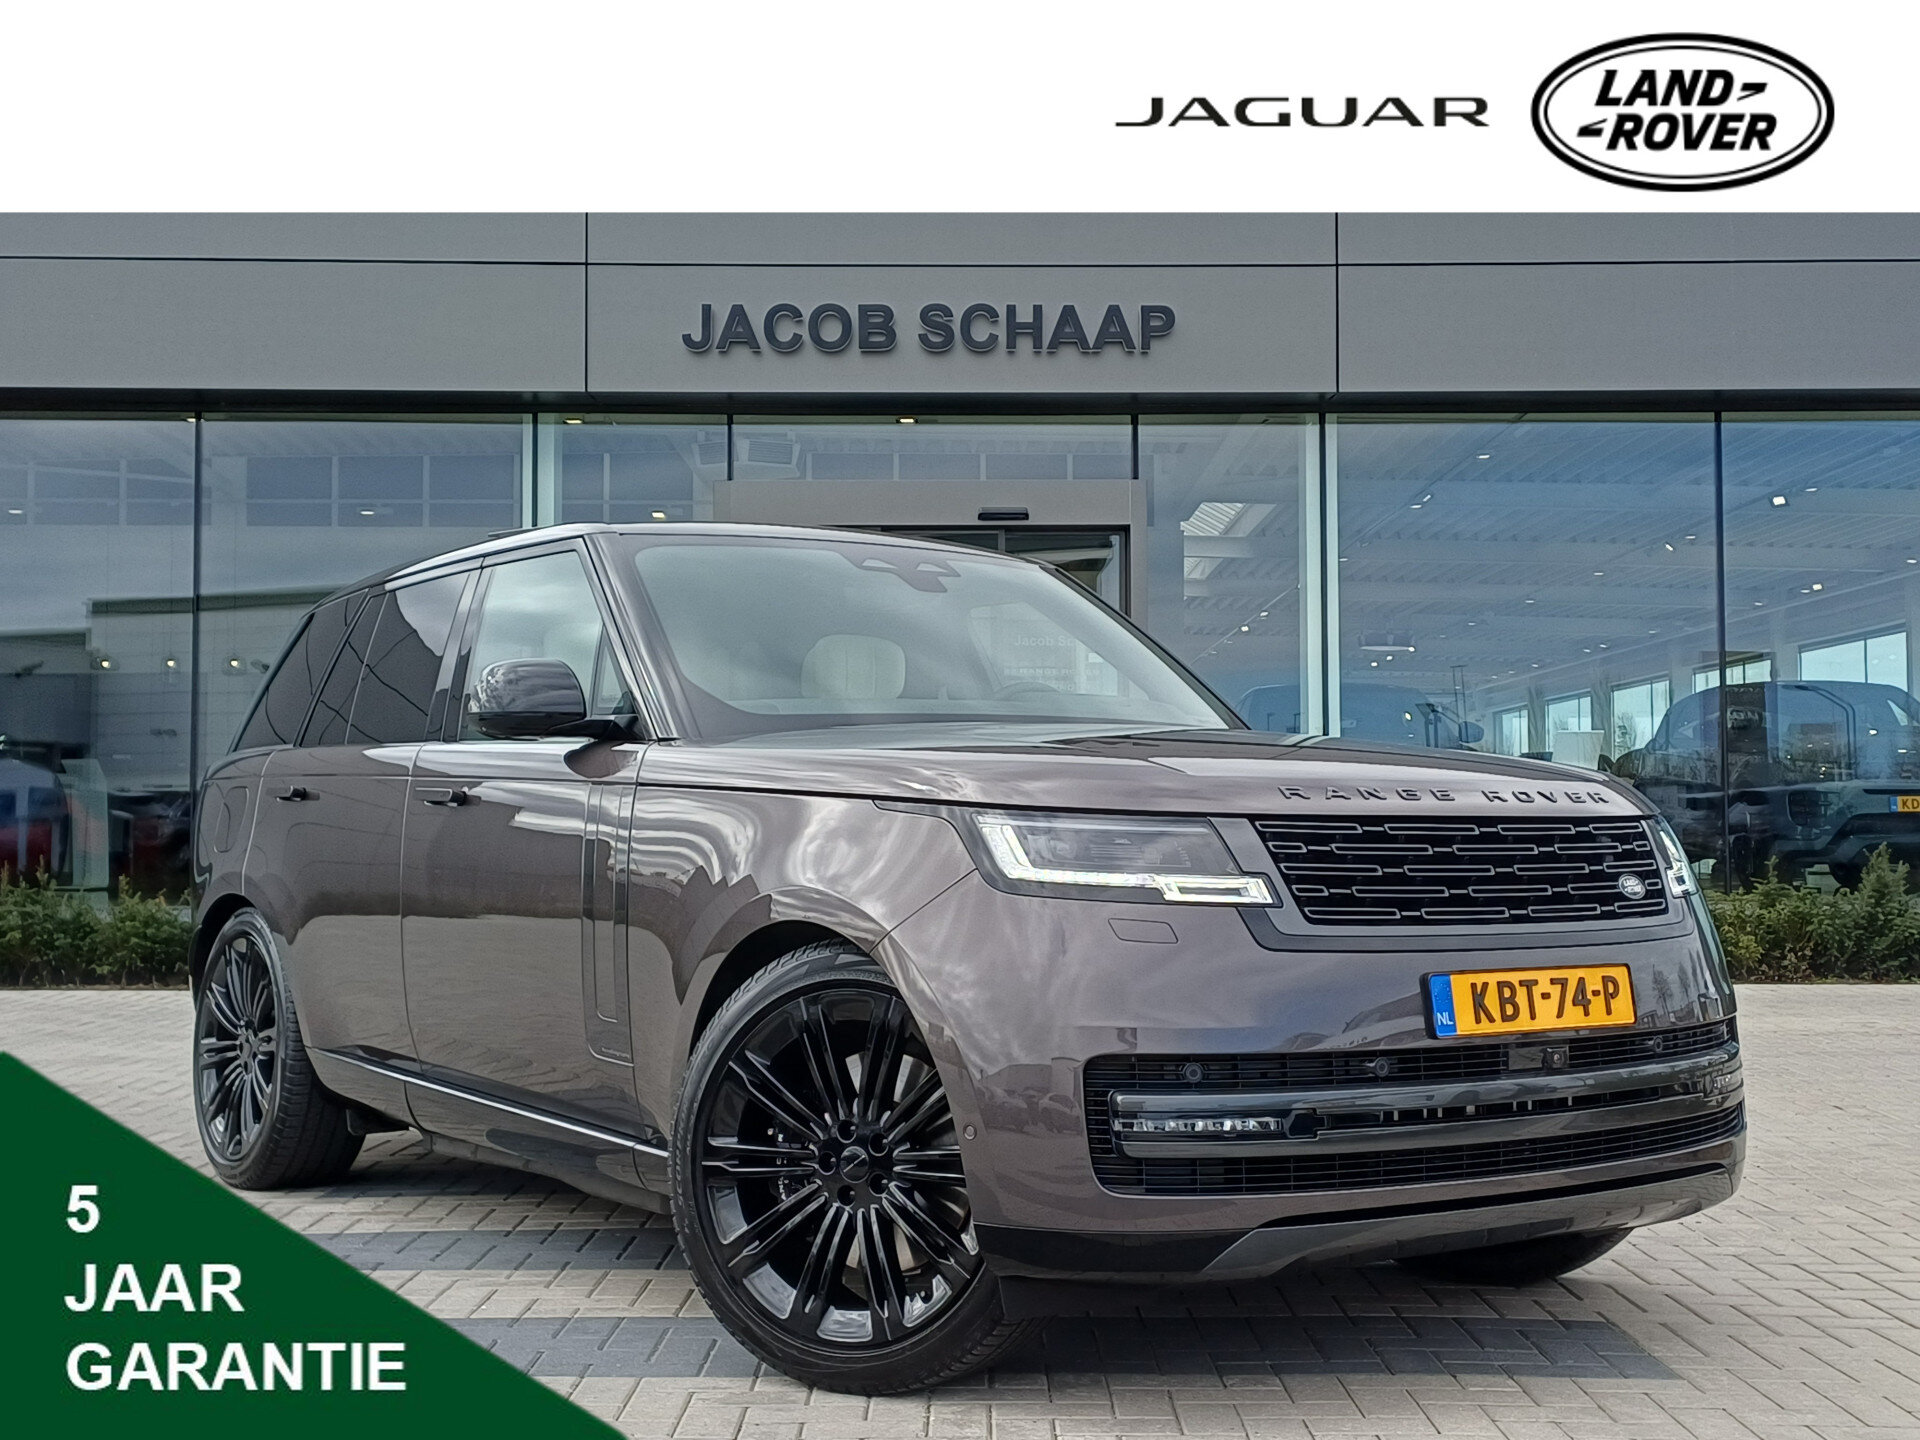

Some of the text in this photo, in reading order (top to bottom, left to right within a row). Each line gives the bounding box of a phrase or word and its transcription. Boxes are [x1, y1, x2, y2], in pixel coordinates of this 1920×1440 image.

[681, 303, 1177, 353] JACOB SCHAAP
[1278, 785, 1610, 804] RANGE ROVER
[1470, 974, 1621, 1025] KBT-74-P
[1437, 1012, 1455, 1026] NL
